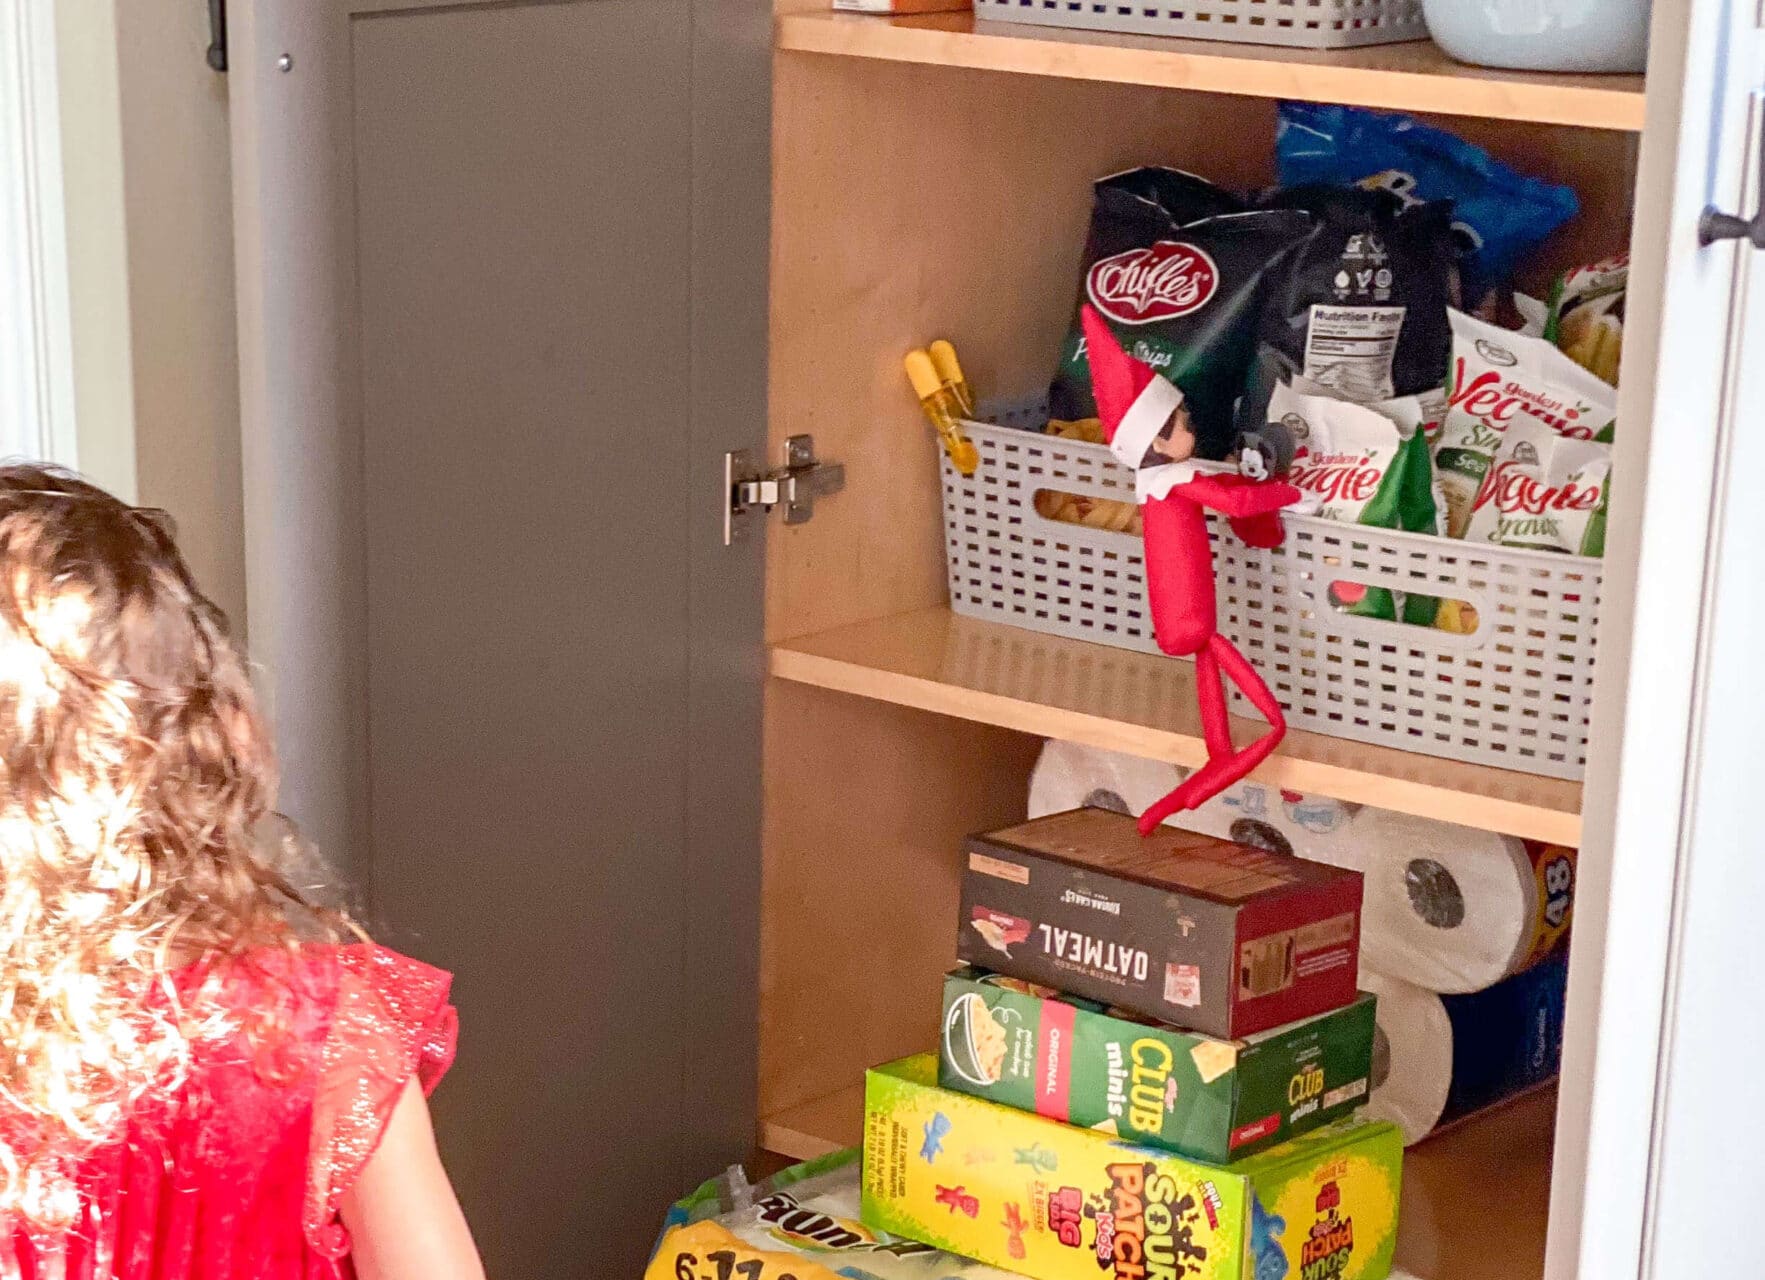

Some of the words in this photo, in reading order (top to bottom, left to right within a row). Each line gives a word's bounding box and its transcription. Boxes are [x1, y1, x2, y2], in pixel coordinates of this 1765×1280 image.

[1314, 310, 1369, 321] Nutrition
[1039, 923, 1149, 981] OATMEAL
[1045, 1027, 1060, 1096] ORIGINAL
[1105, 1041, 1124, 1118] minis
[1130, 1037, 1173, 1135] CLUB
[1289, 1071, 1325, 1107] CLUB
[1058, 1186, 1082, 1248] BIG
[1096, 1212, 1114, 1260] Kids
